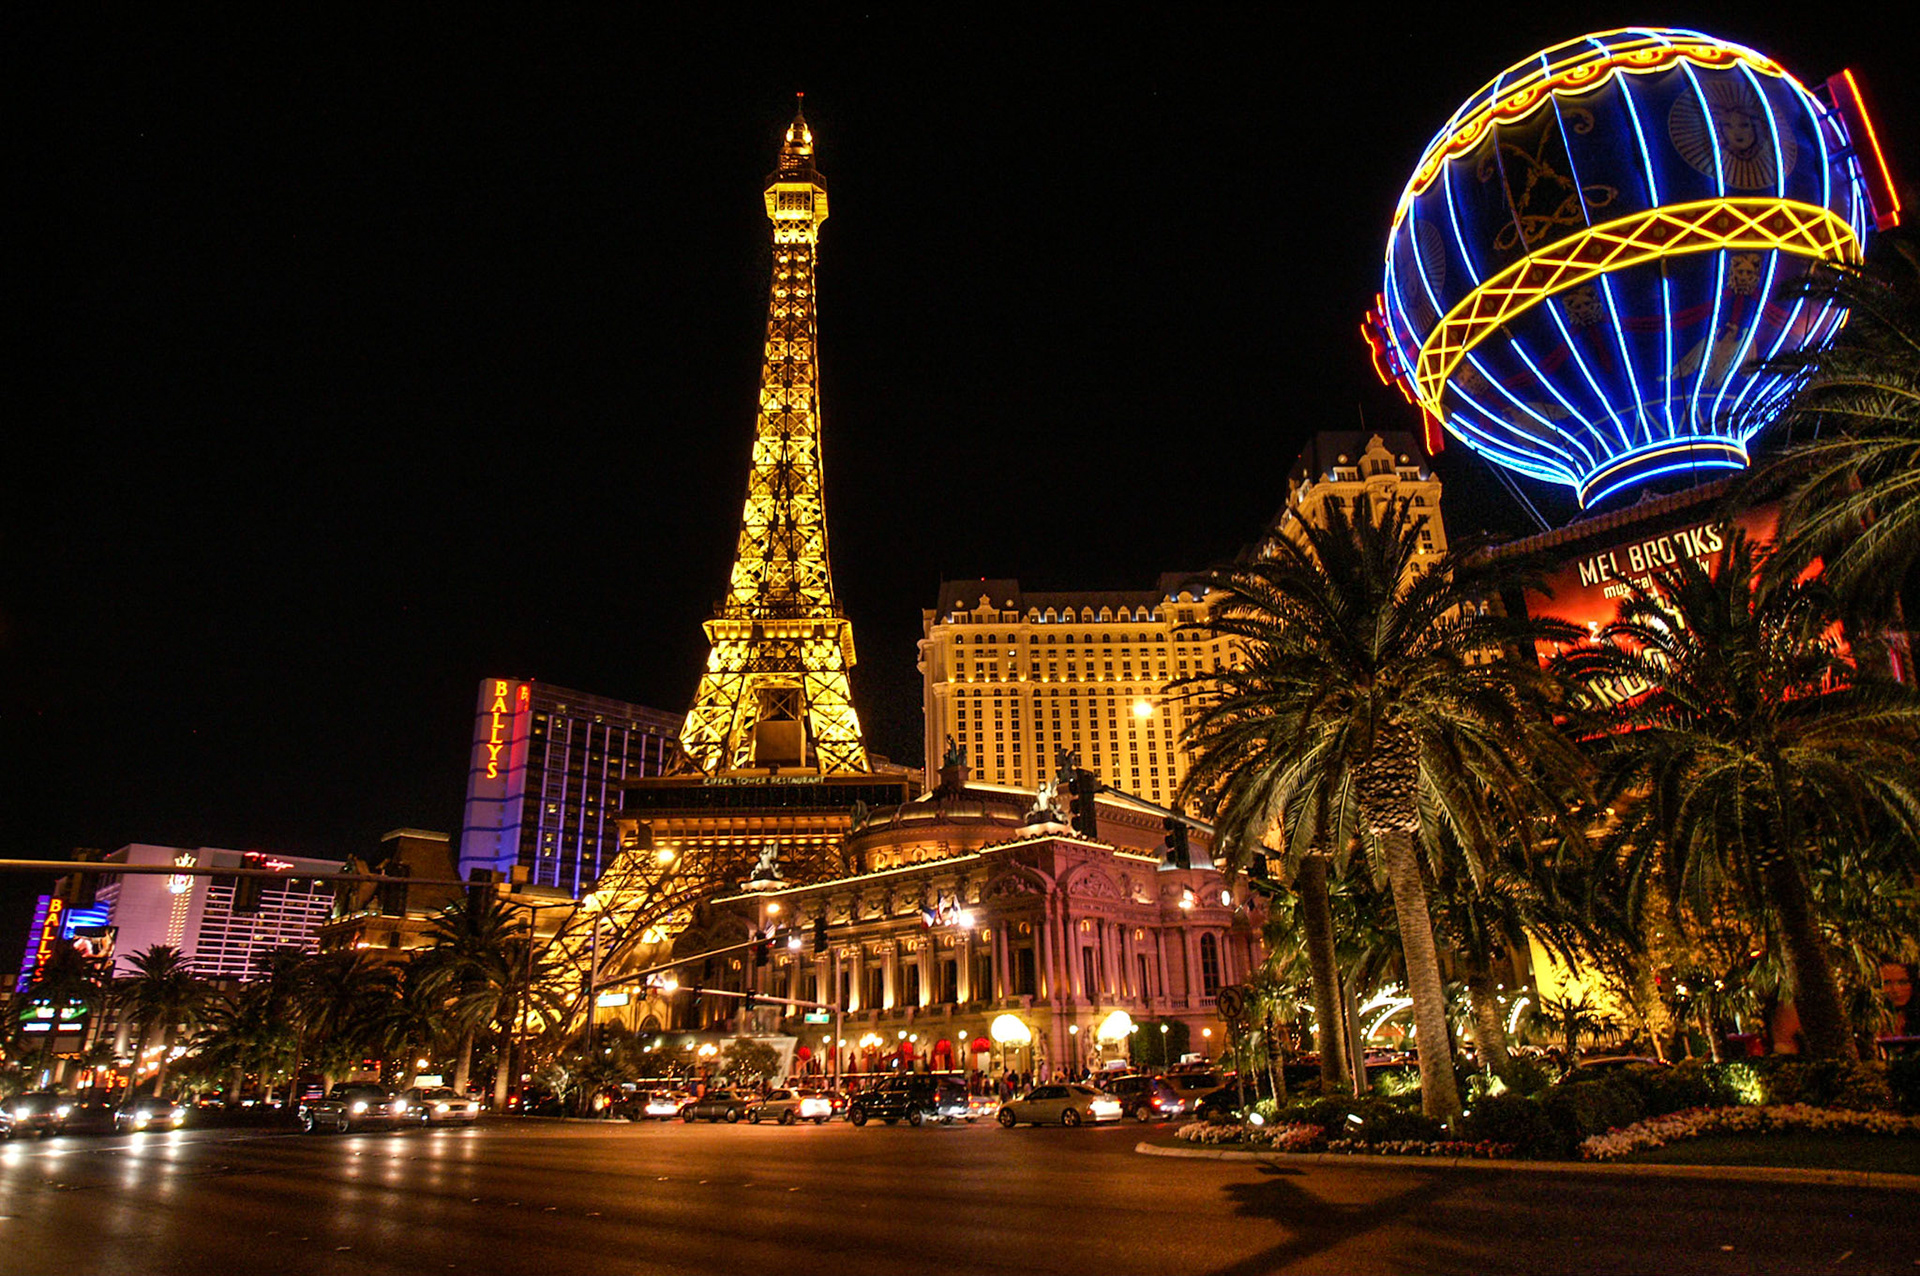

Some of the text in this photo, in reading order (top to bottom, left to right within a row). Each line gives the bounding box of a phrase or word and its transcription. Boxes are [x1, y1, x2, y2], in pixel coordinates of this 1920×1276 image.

[1578, 551, 1626, 587] MEL
[486, 680, 508, 779] BALLYS
[702, 775, 825, 786] EIFFEL TOWER RESTAURANT
